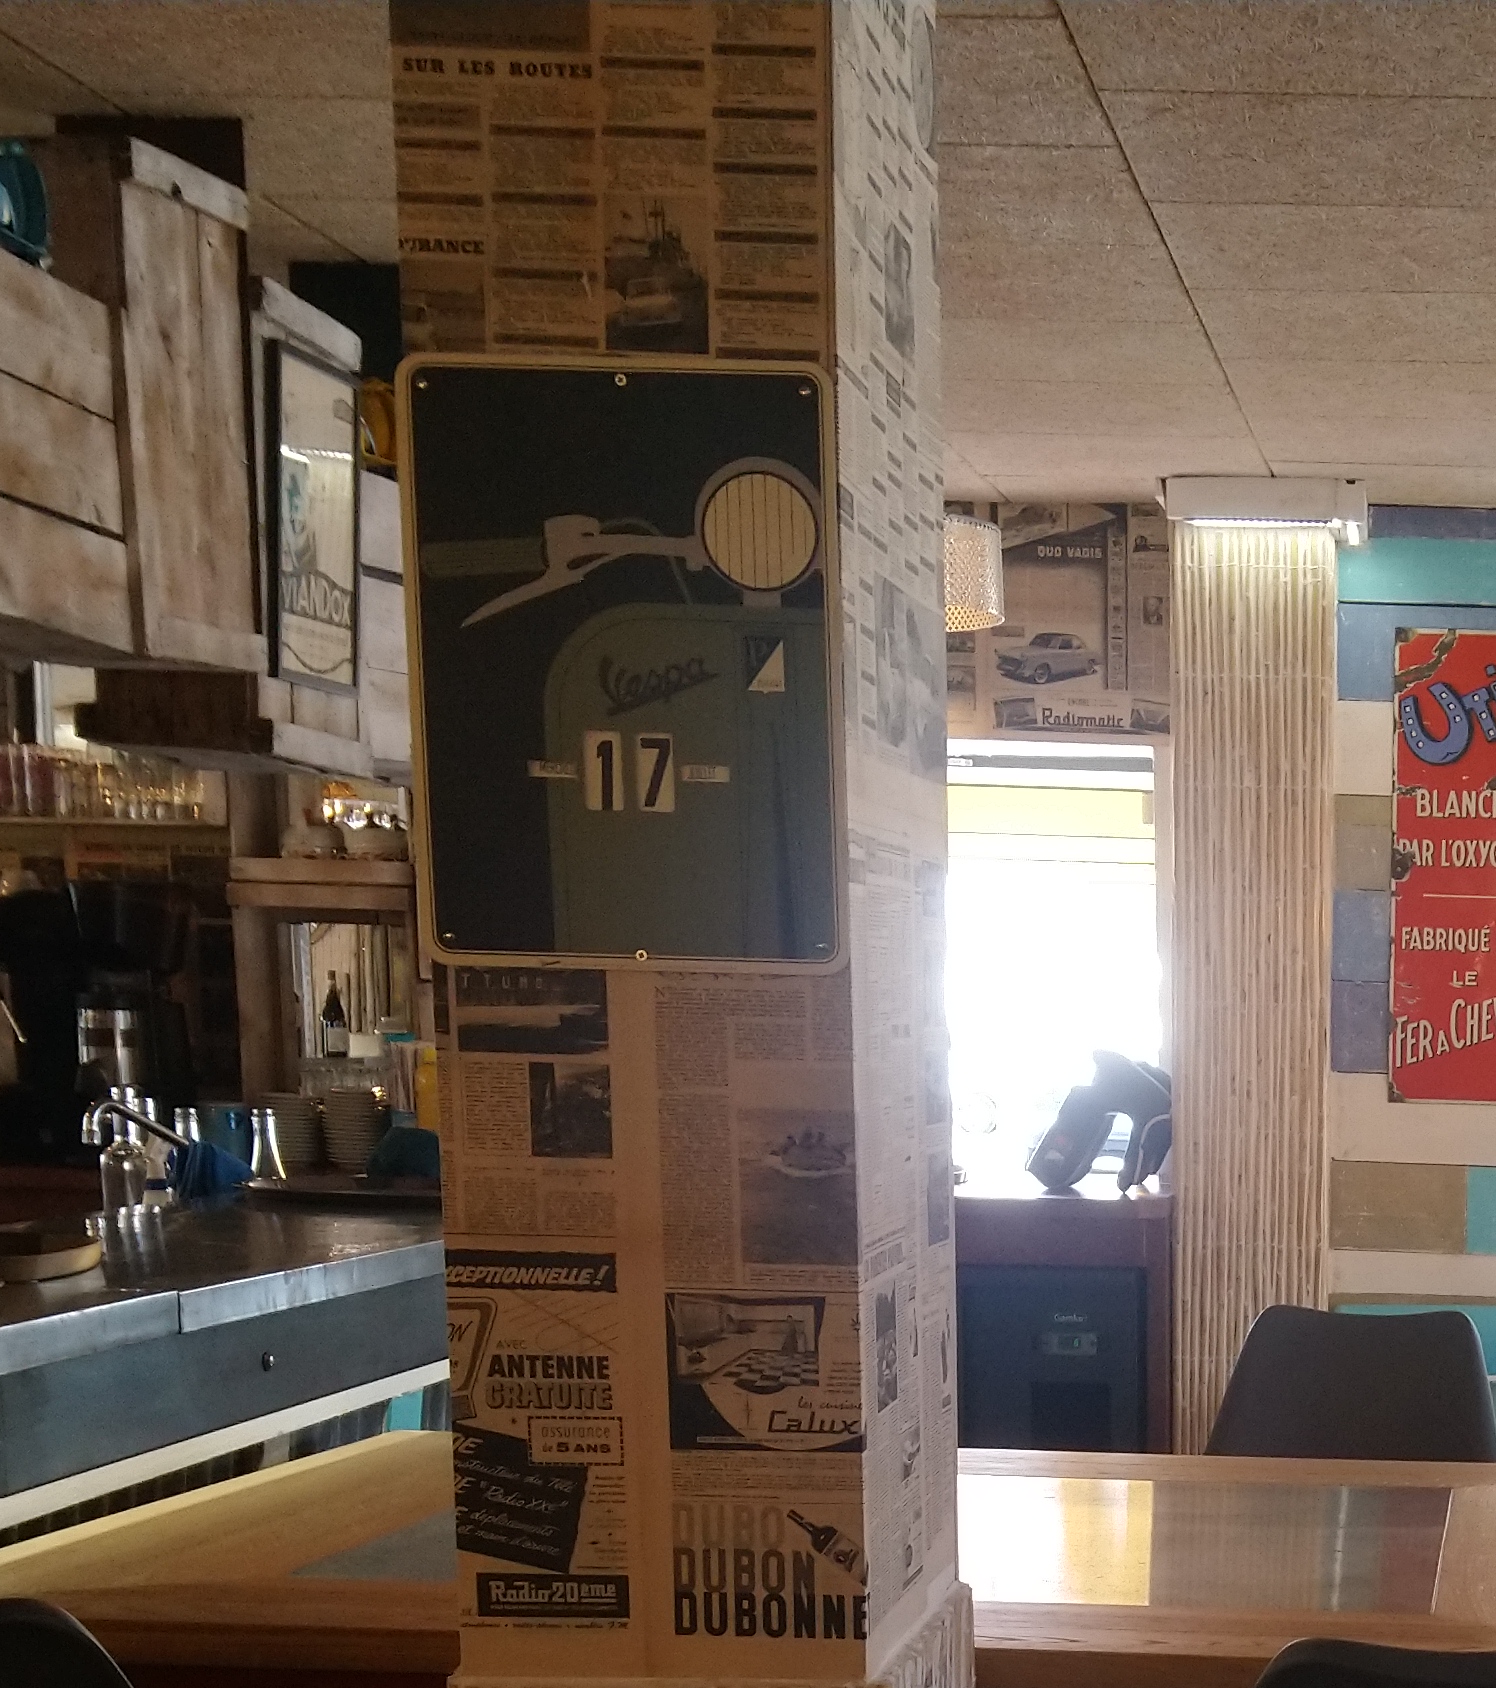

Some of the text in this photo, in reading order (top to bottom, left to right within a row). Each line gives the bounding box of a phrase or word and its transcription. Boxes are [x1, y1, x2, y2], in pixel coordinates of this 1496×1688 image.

[403, 57, 593, 79] SUR LES ROUTES
[1037, 545, 1062, 558] QUO
[283, 573, 351, 627] VIANDOX
[598, 655, 719, 717] Vespa
[1042, 707, 1124, 729] Radiomatic
[1398, 839, 1434, 869] PAR
[1401, 925, 1491, 954] FABRIQUÉ
[1451, 970, 1478, 987] LE
[1395, 1013, 1433, 1068] FER
[1436, 1029, 1450, 1056] A
[496, 1339, 528, 1351] AVEC
[487, 1353, 611, 1381] ANTENNE
[485, 1381, 613, 1411] GRATUITE
[540, 1425, 611, 1440] assurance
[767, 1410, 861, 1435] Calux
[541, 1442, 612, 1455] de 5 ANS
[673, 1502, 787, 1549] DUBO
[673, 1547, 817, 1594] DUBON
